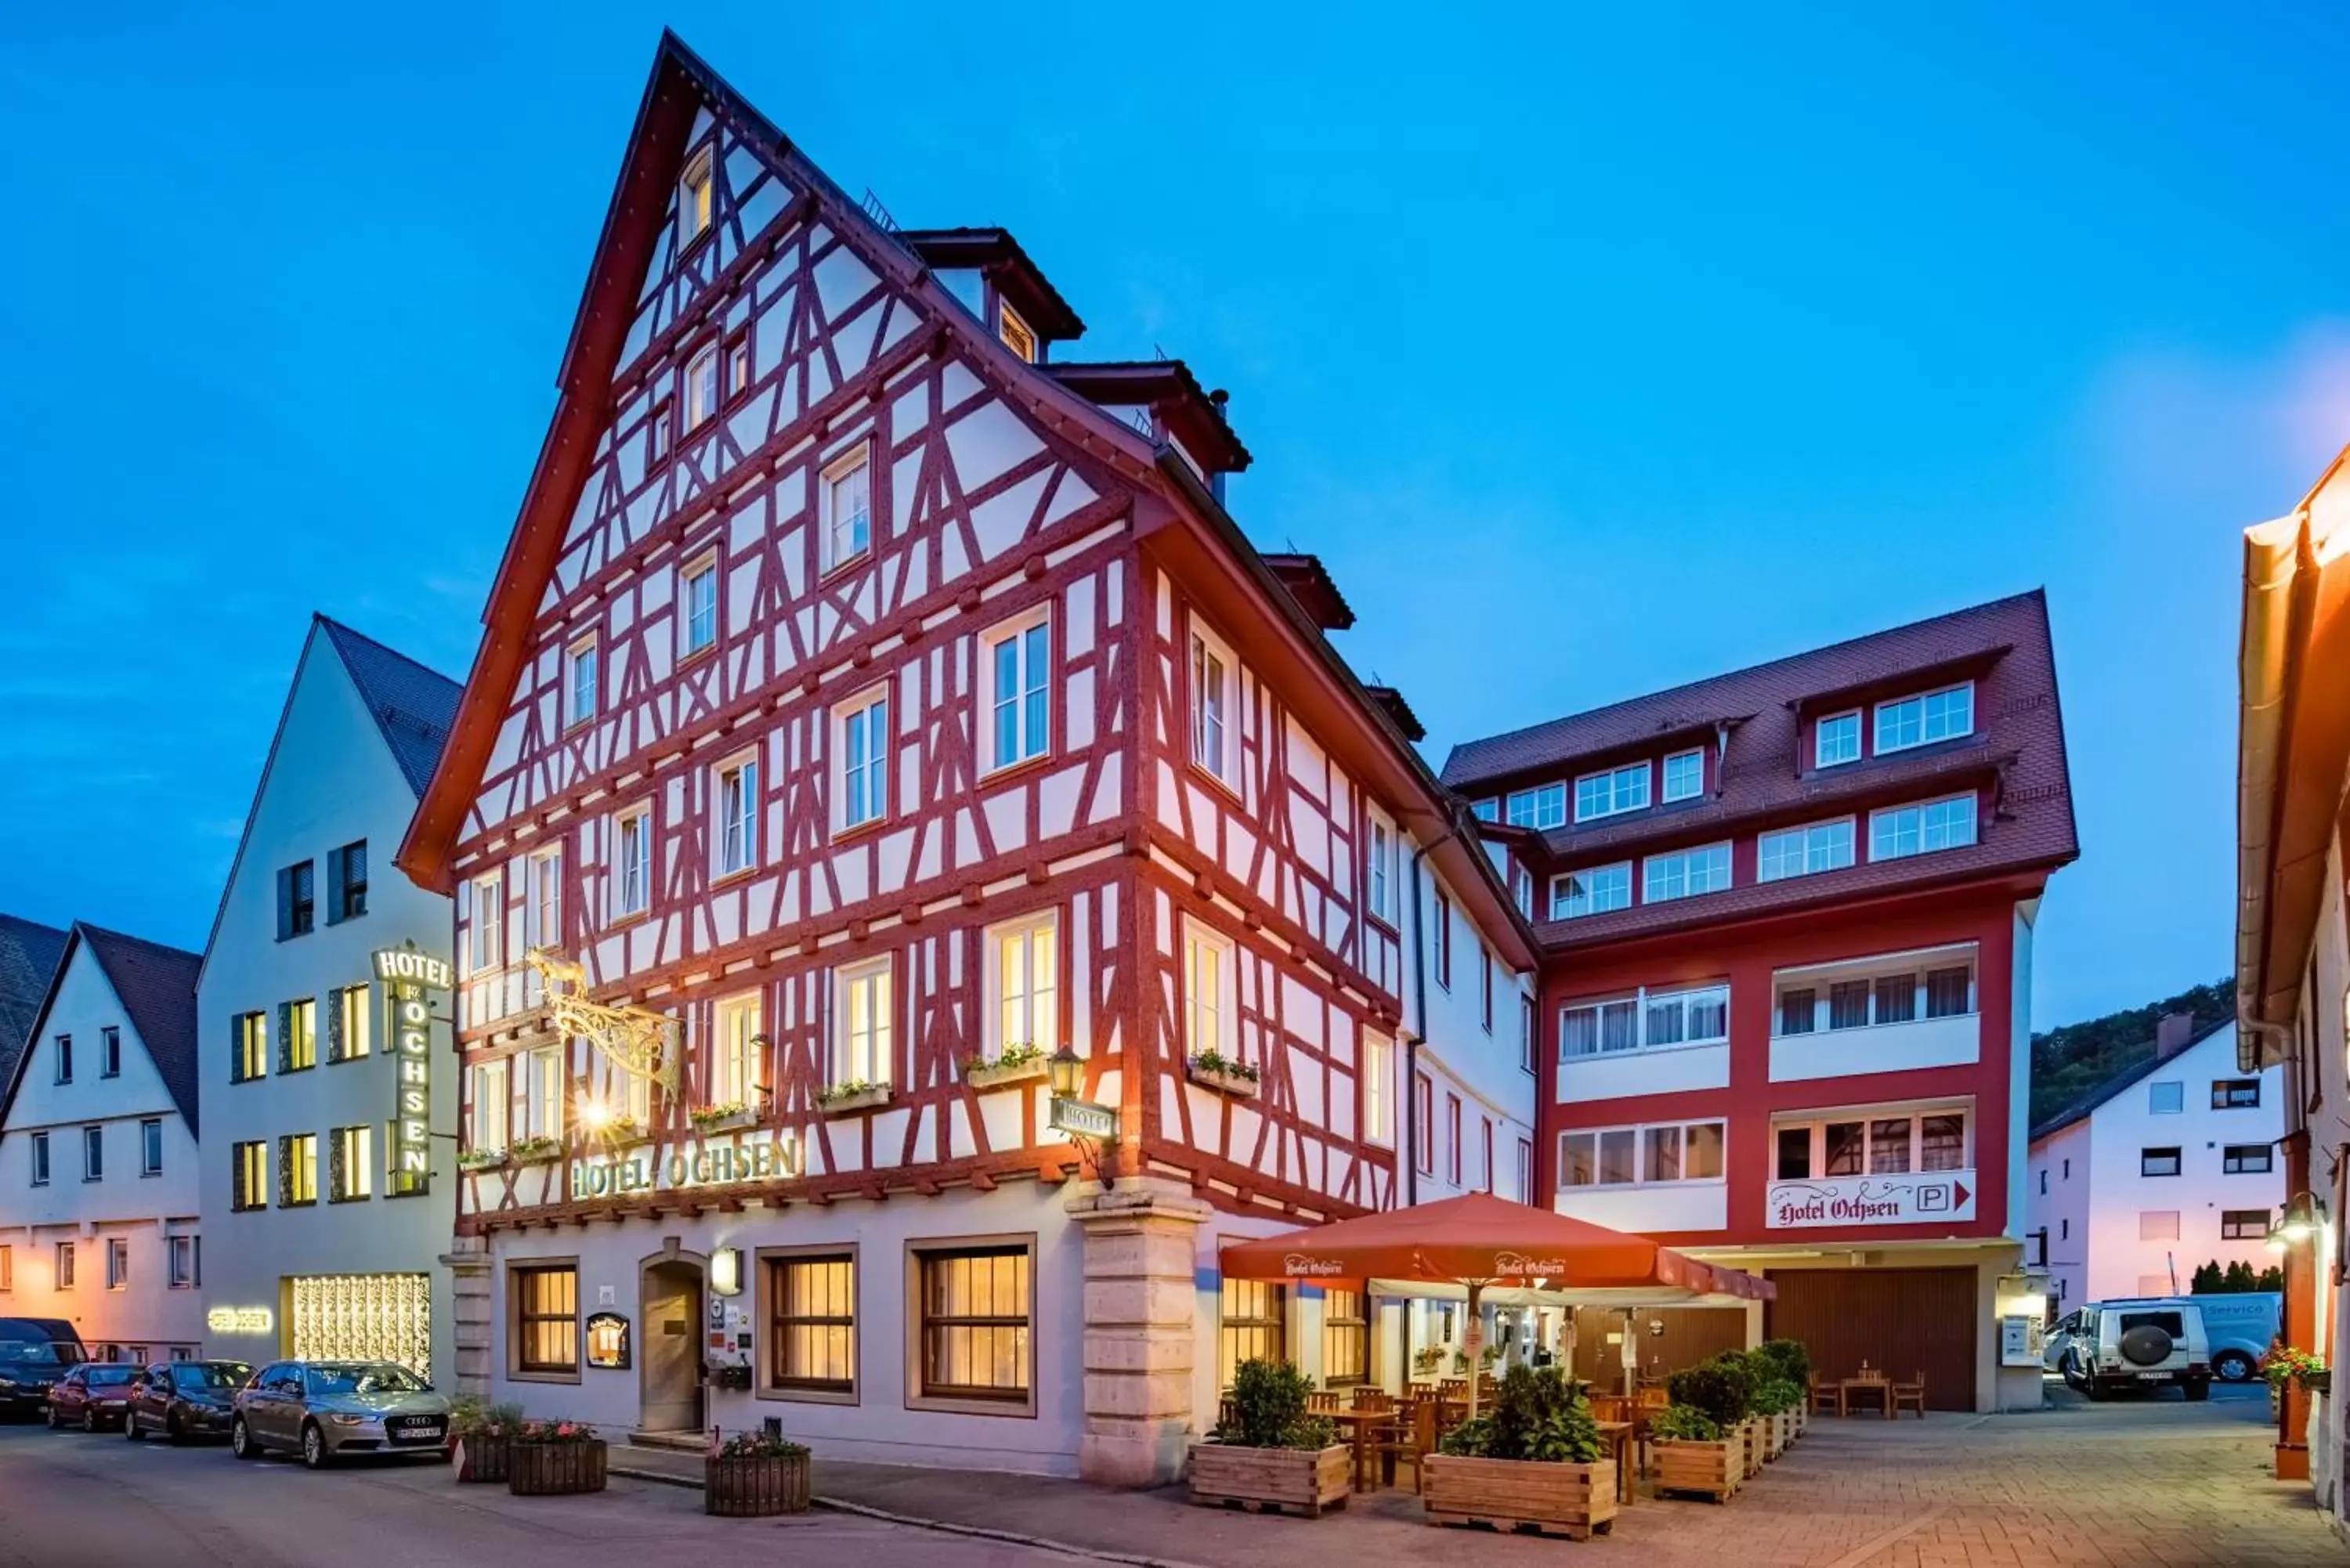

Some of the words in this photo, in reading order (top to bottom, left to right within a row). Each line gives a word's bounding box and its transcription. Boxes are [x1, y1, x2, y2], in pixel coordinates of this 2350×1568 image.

[378, 952, 452, 988] HOTEL
[403, 1002, 427, 1172] OCHSEN
[1068, 1105, 1111, 1131] HOTEL
[573, 1158, 651, 1198] HOTEL
[666, 1138, 796, 1187] OCHSEN
[1778, 1196, 1825, 1226] Hotel
[1830, 1194, 1900, 1222] Ochsen
[1924, 1188, 1942, 1208] P
